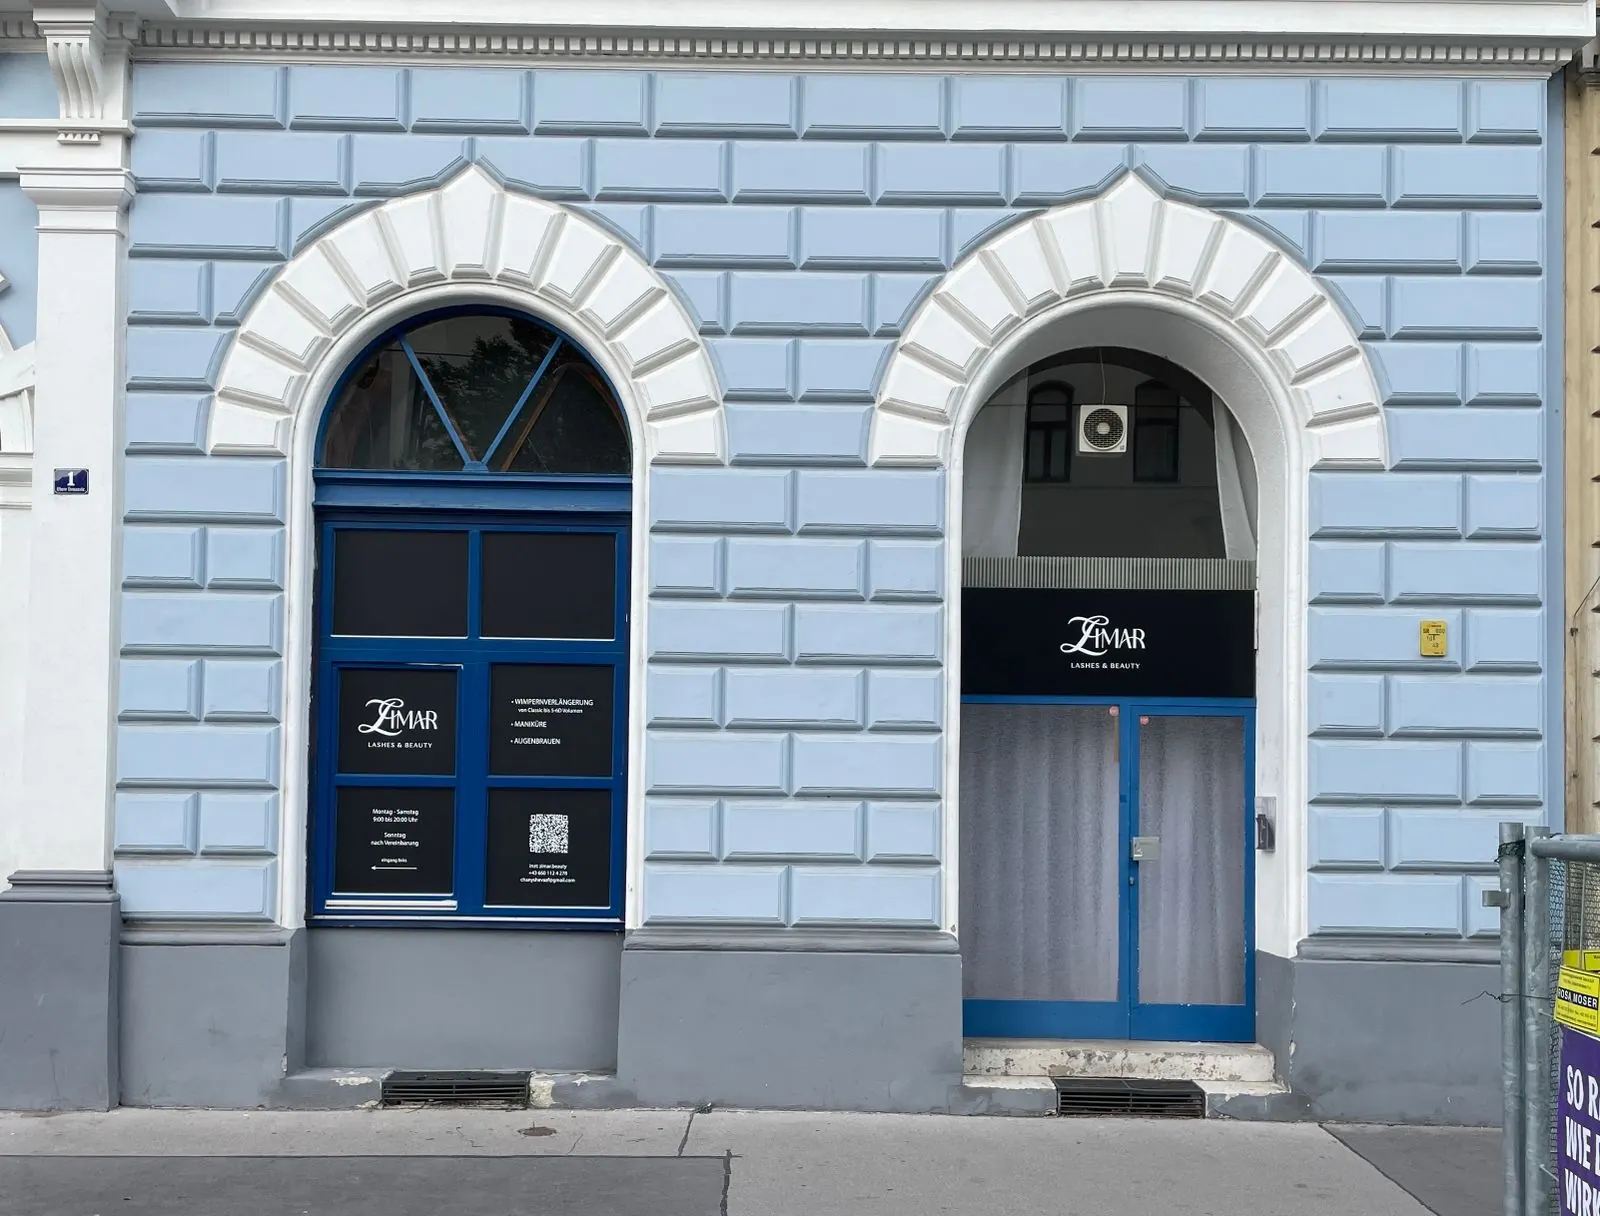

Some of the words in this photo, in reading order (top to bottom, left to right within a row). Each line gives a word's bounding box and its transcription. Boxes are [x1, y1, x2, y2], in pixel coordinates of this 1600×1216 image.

[67, 471, 75, 486] 1
[514, 698, 594, 706] WIMPERNVERLÄNGERUNG
[514, 720, 547, 728] MANIKÜRE
[372, 808, 393, 816] Montag
[1573, 993, 1598, 1009] MOSER
[1566, 1064, 1584, 1111] SO
[1565, 1115, 1592, 1170] WIE
